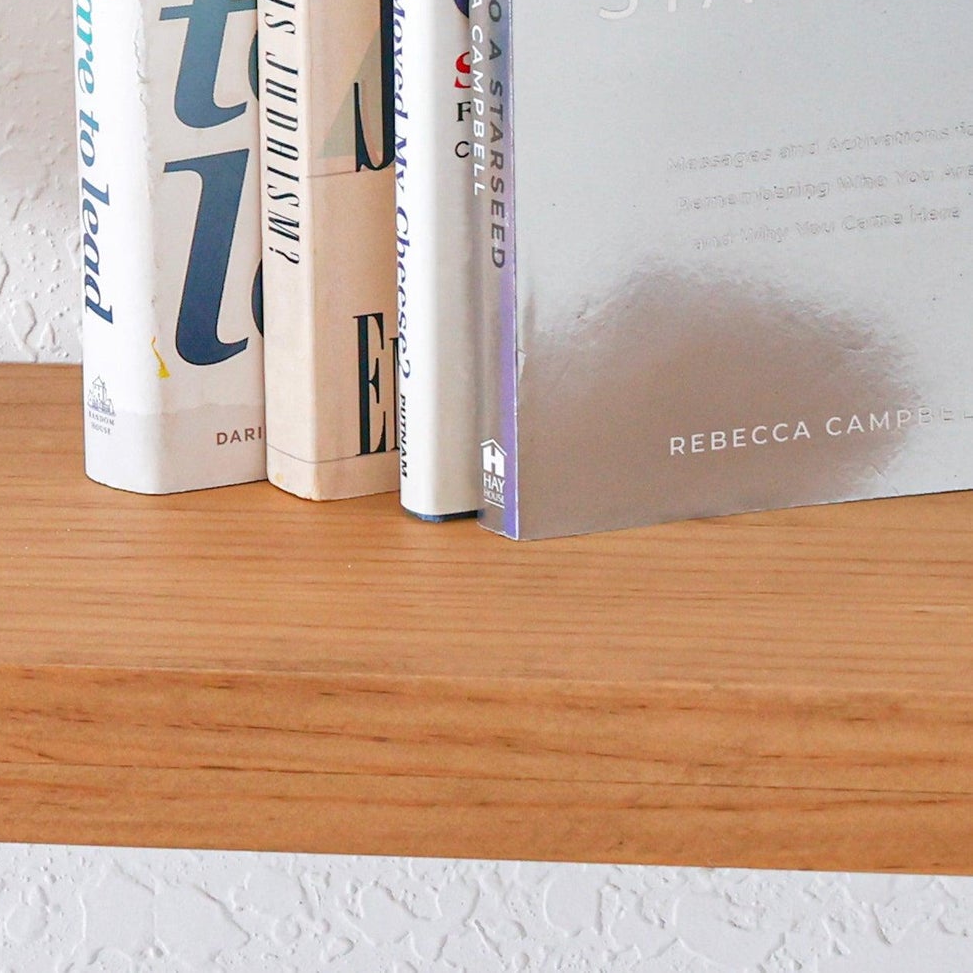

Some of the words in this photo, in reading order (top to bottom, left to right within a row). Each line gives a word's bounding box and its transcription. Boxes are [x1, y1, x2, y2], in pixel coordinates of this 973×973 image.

[489, 39, 502, 60] A
[79, 109, 100, 168] to
[472, 25, 486, 196] CAMPBELL
[265, 51, 300, 264] JUDAISM?
[489, 79, 506, 269] STARSEED
[82, 177, 113, 325] lead
[400, 394, 409, 479] PUTNAM
[669, 420, 812, 456] REBECCA
[483, 472, 505, 494] HAY
